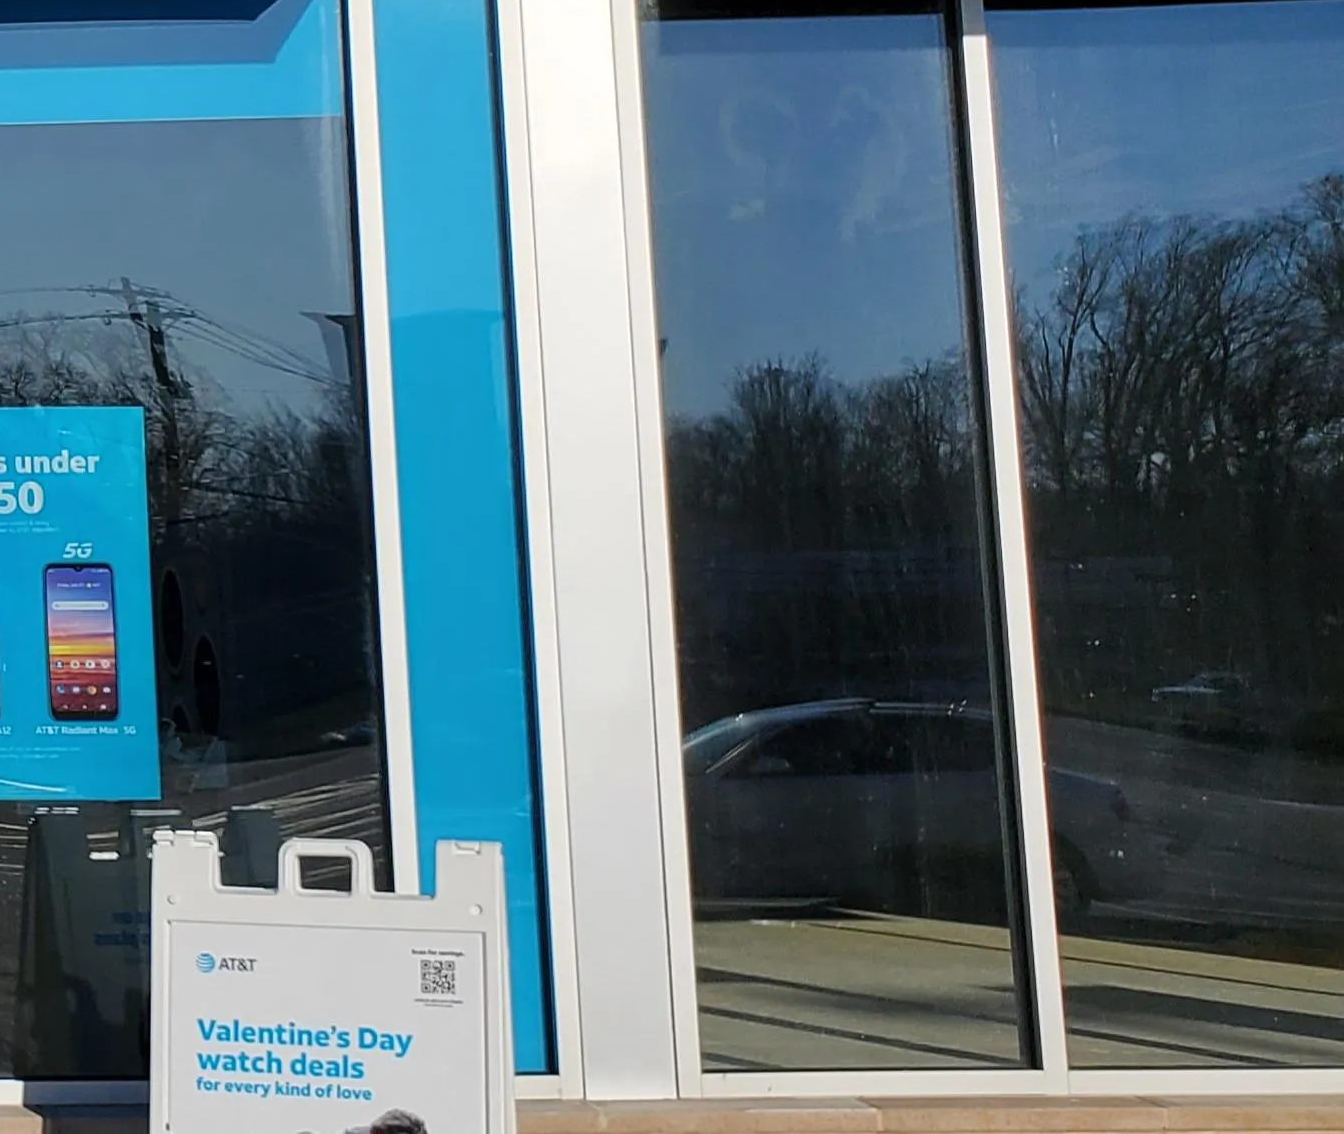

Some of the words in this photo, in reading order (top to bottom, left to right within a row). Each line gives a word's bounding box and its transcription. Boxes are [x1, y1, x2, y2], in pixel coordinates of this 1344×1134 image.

[14, 450, 99, 474] under
[63, 543, 92, 558] 5G
[36, 726, 59, 734] AT&T
[219, 958, 257, 971] AT&T
[197, 1019, 350, 1048] Valentine's
[359, 1028, 412, 1058] Day
[197, 1050, 282, 1074] watch
[290, 1052, 364, 1079] deals
[196, 1077, 221, 1091] for
[225, 1082, 271, 1098] every
[275, 1081, 311, 1097] kind
[315, 1084, 333, 1098] of
[337, 1084, 372, 1100] love
